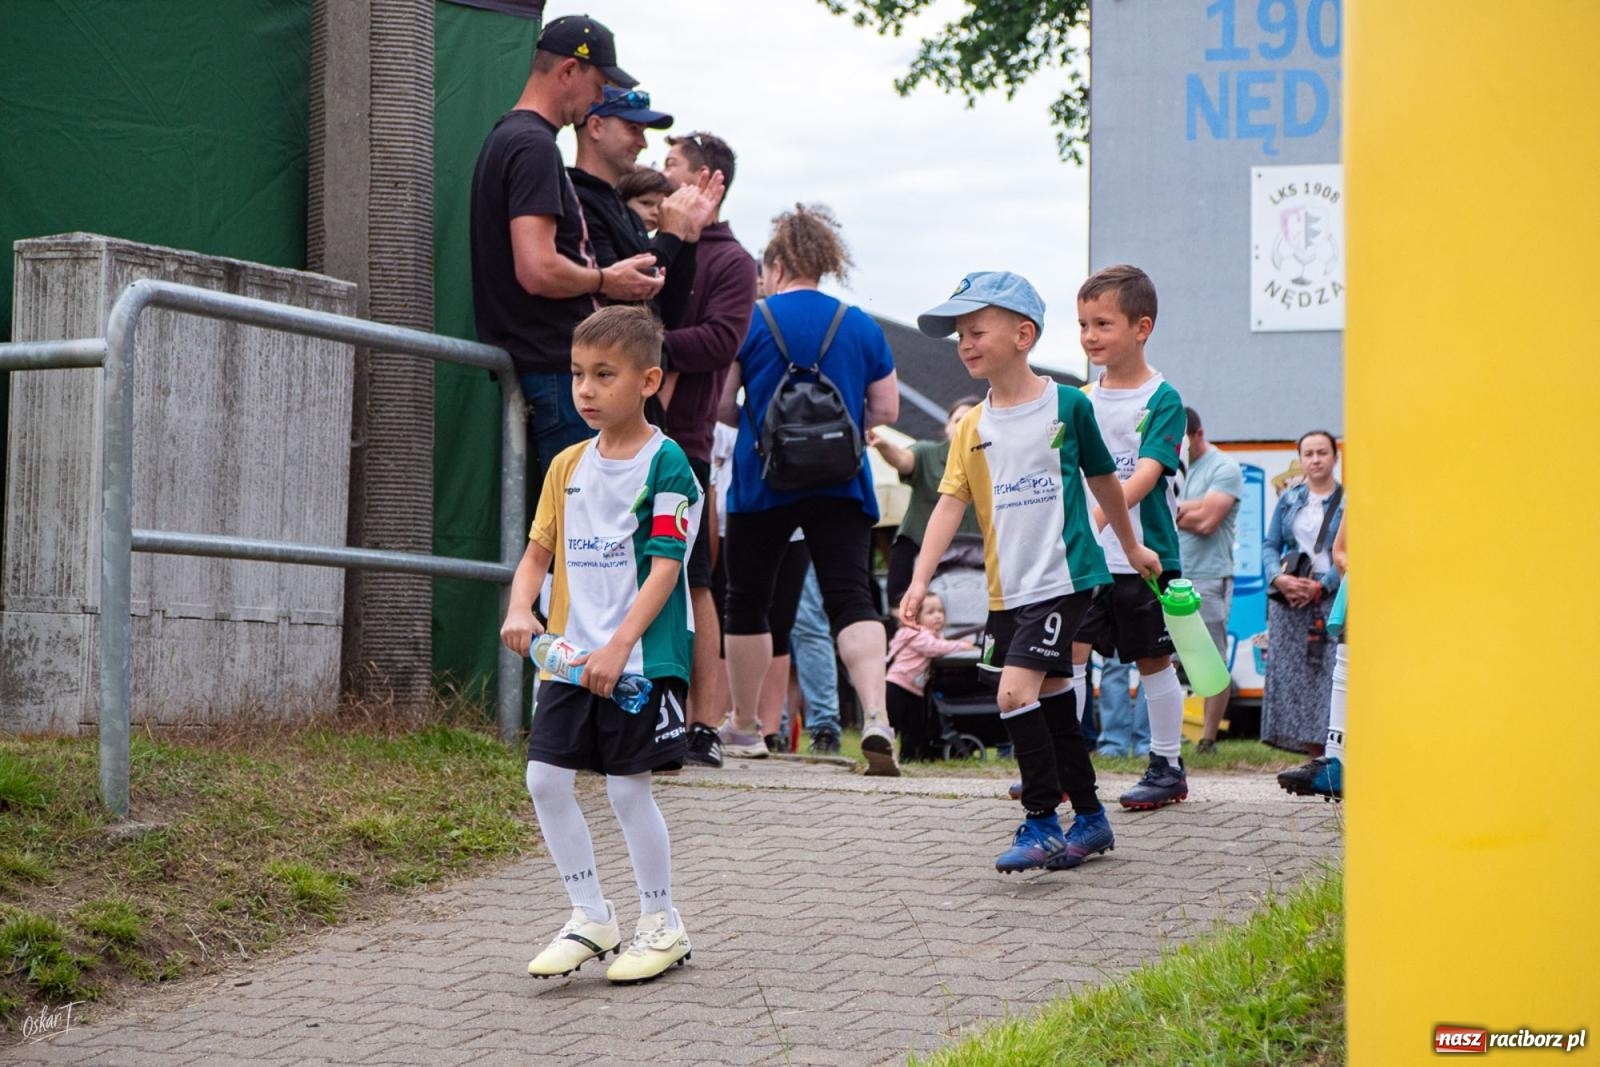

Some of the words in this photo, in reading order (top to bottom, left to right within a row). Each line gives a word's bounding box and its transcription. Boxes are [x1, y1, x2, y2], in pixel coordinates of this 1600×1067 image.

[1185, 68, 1341, 156] NĘD
[1269, 183, 1298, 205] LKS
[1303, 181, 1341, 204] 1908
[1263, 279, 1345, 311] NĘDZA
[1042, 611, 1063, 647] 9
[1029, 645, 1061, 658] regio
